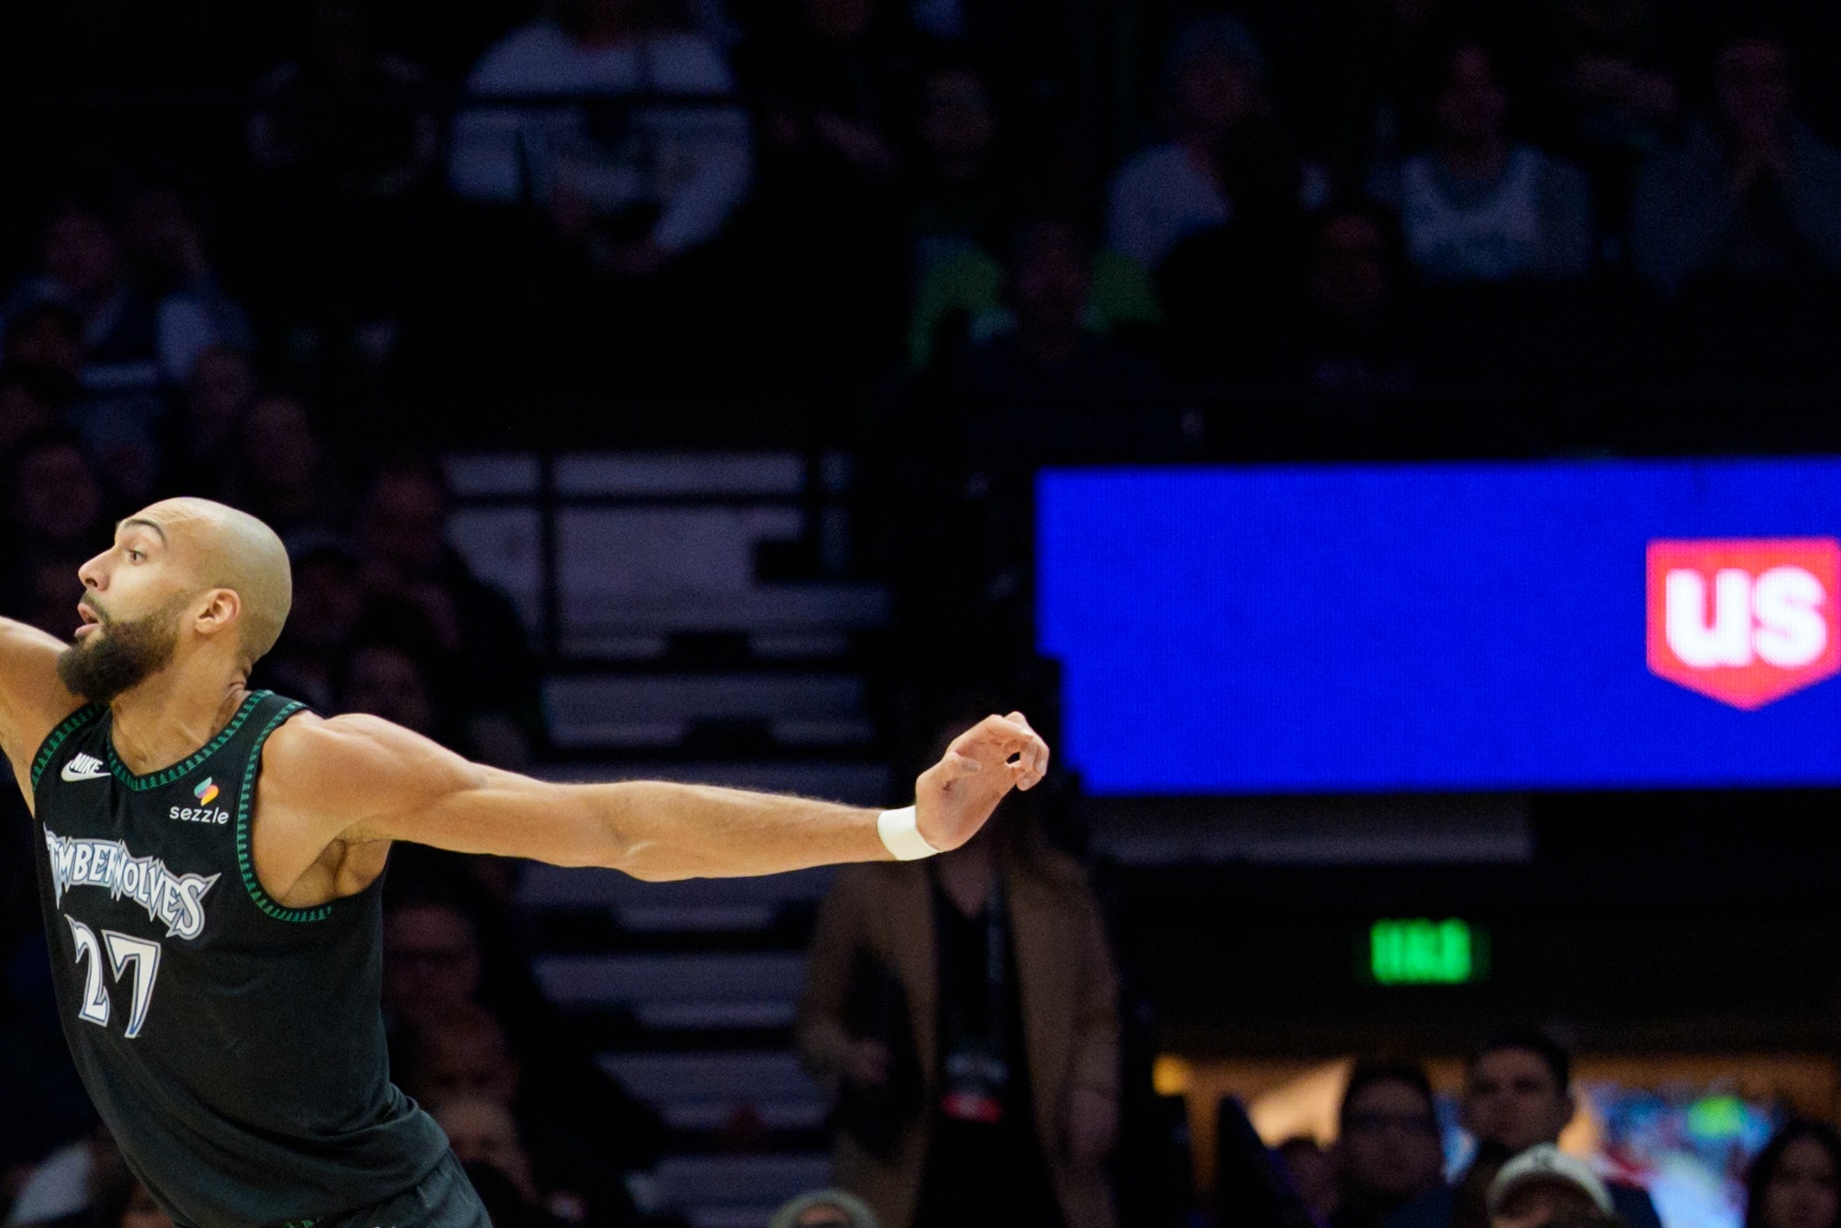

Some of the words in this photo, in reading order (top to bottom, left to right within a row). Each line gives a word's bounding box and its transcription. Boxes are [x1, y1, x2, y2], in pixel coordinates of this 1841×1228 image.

[1665, 565, 1828, 669] us
[70, 752, 104, 774] NIKE
[169, 805, 229, 825] sezzle
[63, 913, 162, 1040] 27
